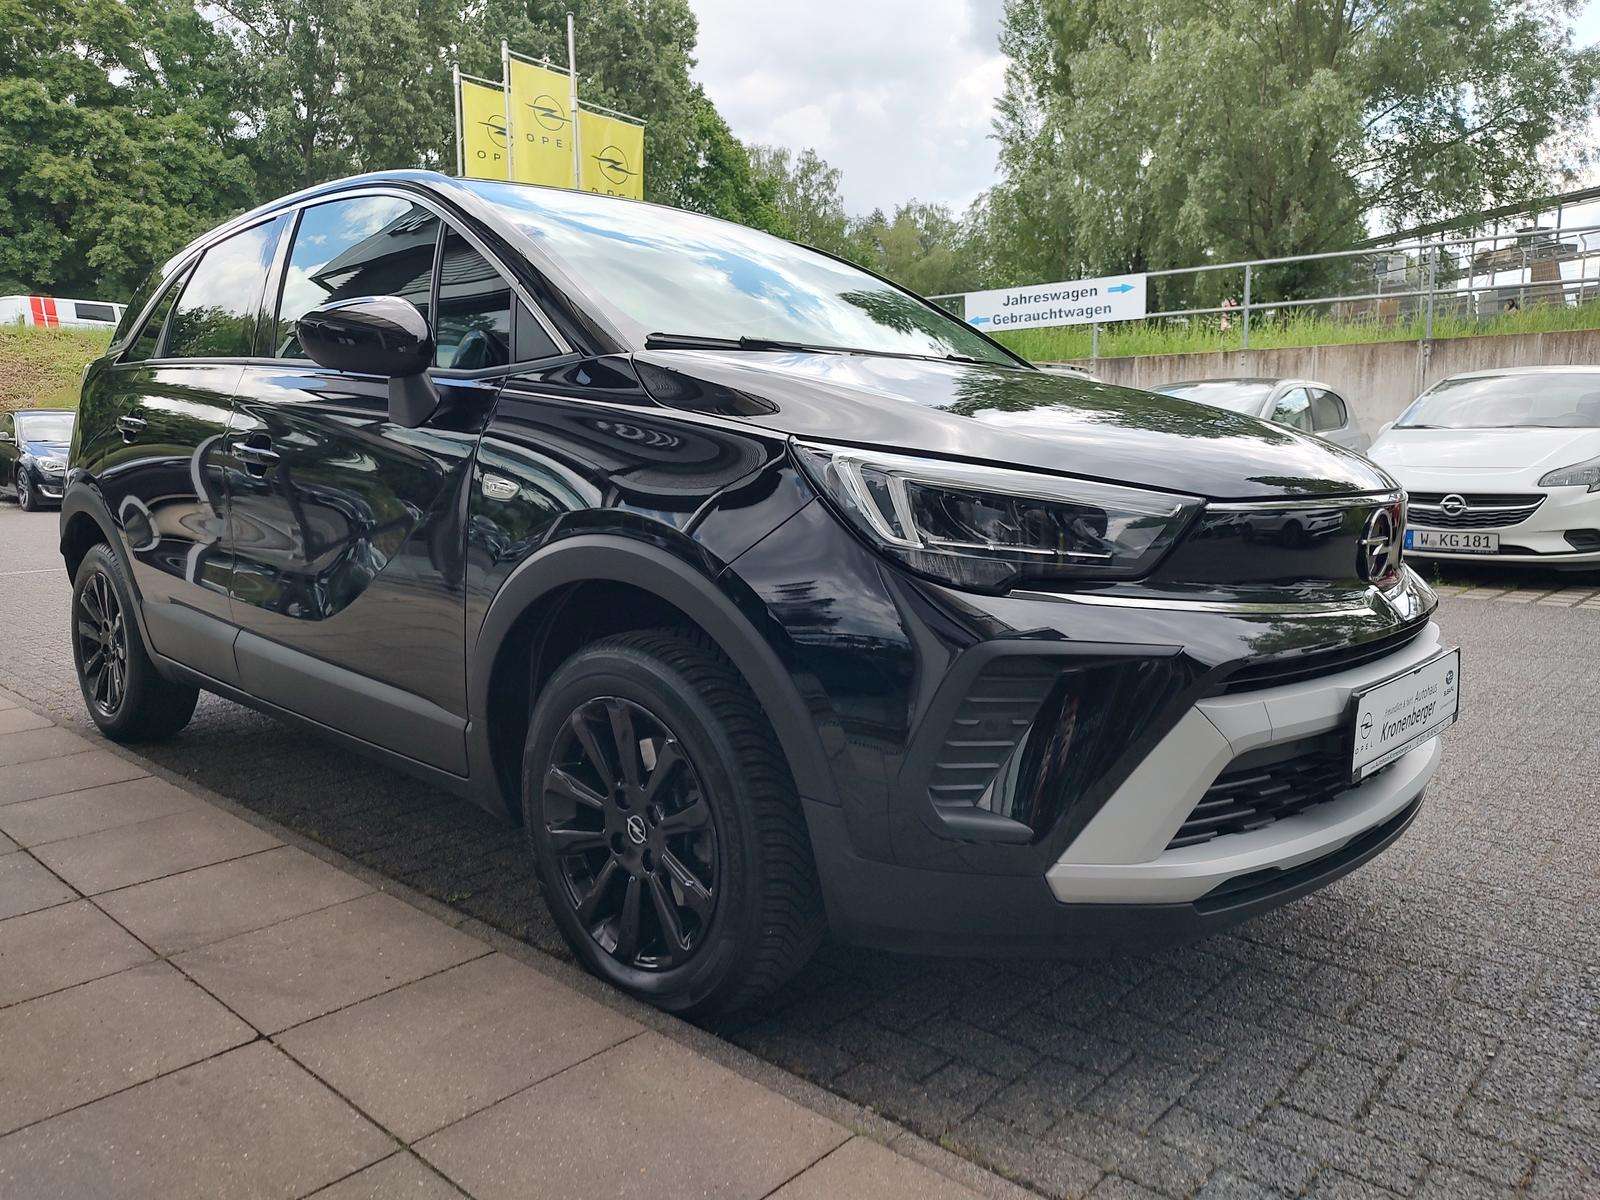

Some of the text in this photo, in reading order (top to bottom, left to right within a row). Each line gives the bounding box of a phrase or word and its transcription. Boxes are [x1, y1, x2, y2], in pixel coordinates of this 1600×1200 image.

[477, 150, 501, 161] OP
[1002, 286, 1098, 306] Jahreswagen
[992, 303, 1112, 326] Gebrauchtwagen
[1420, 532, 1430, 545] W
[1379, 701, 1437, 743] Kronenberger
